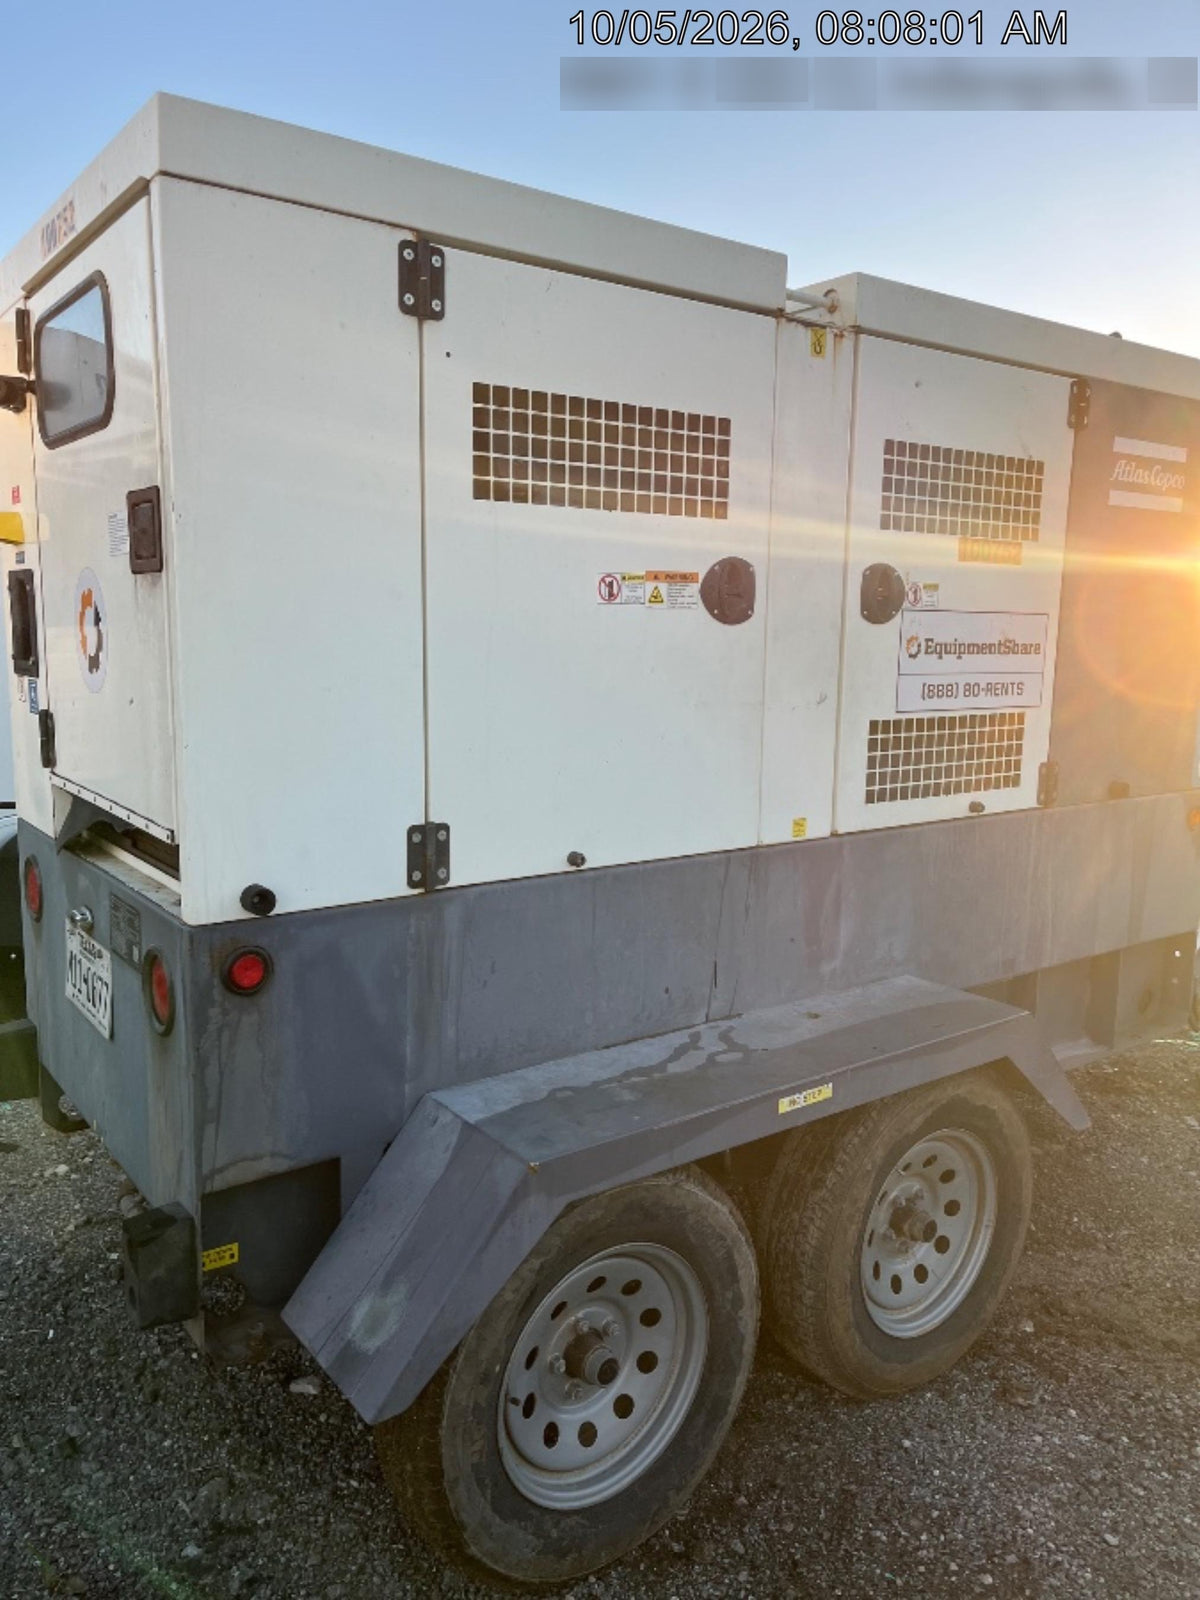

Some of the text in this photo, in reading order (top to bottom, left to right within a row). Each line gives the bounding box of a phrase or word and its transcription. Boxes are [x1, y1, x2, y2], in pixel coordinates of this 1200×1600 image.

[1110, 459, 1149, 485] Atlas
[924, 637, 1041, 660] EquipmentShare
[921, 682, 1025, 700] (888) 80-RENTS
